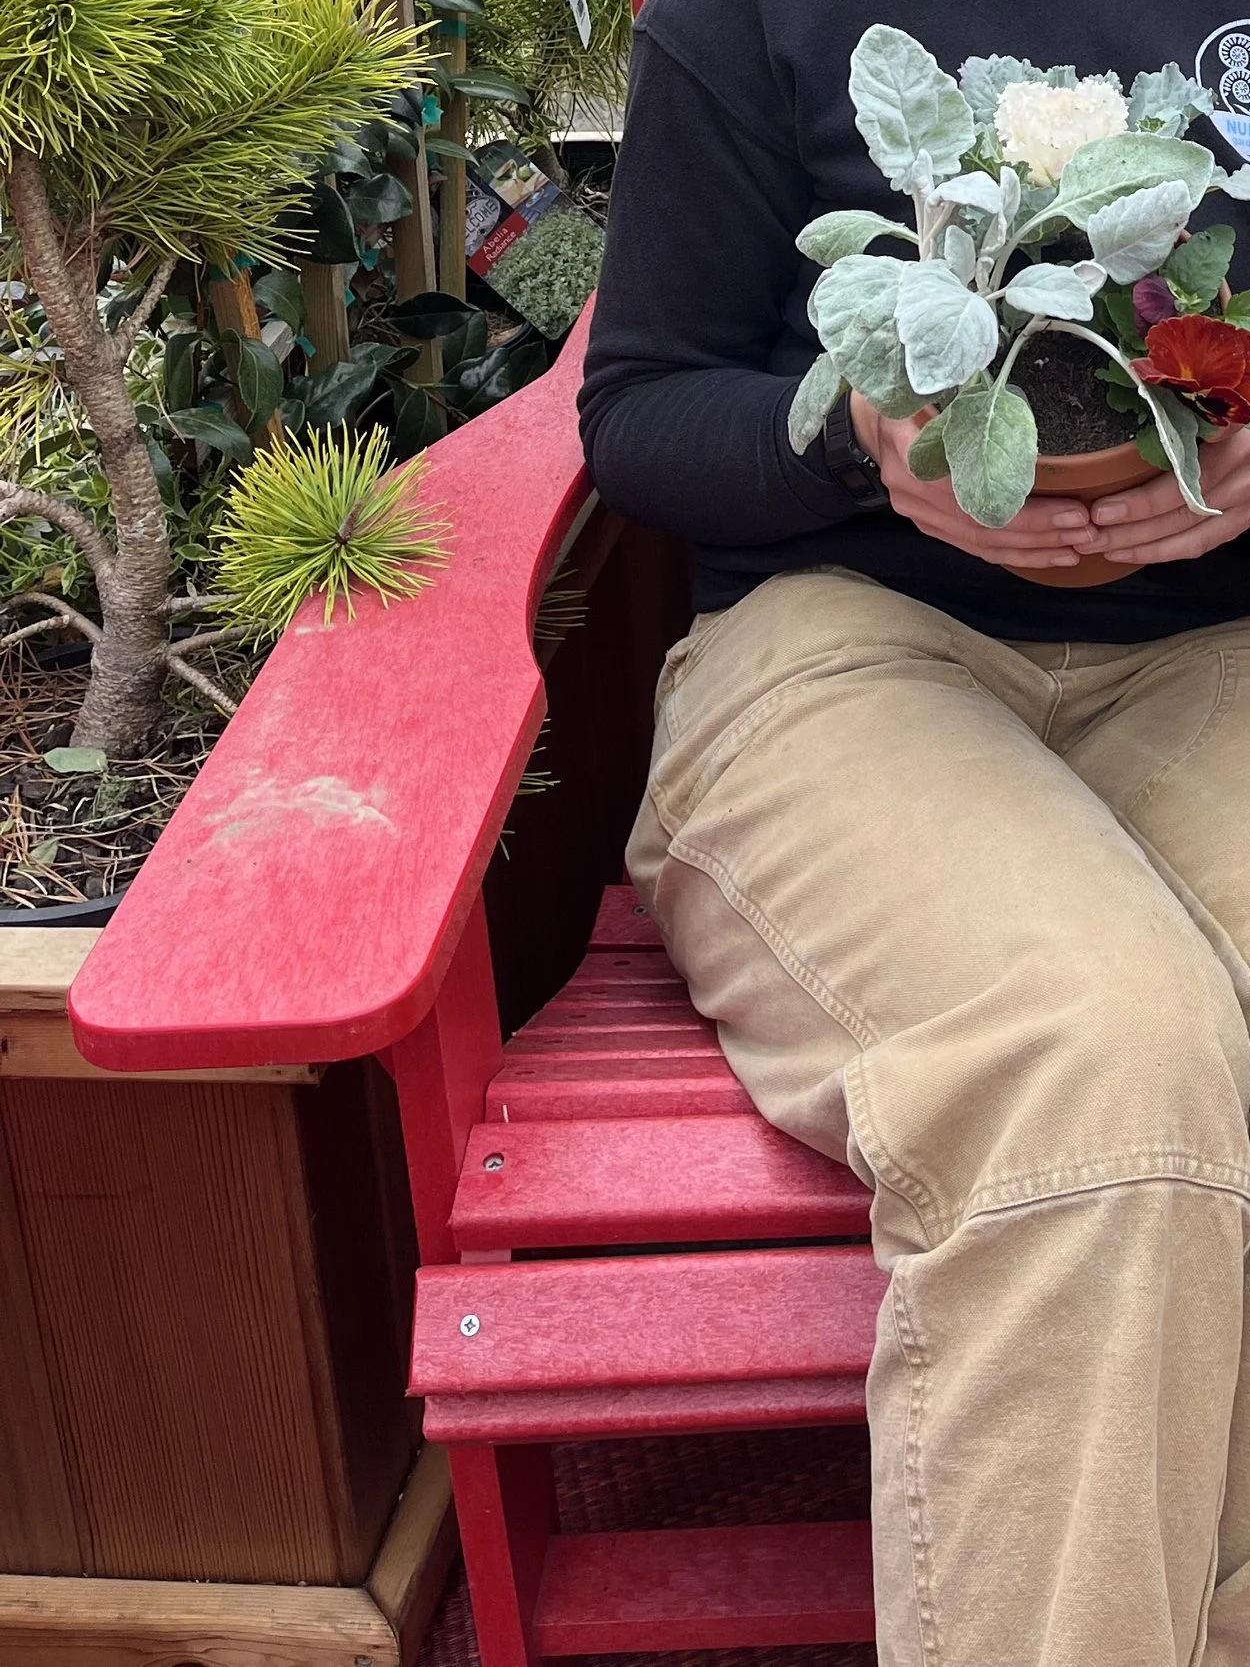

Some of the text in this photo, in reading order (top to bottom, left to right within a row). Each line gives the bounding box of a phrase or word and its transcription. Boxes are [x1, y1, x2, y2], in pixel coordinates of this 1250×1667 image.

[465, 198, 499, 239] LCOME
[482, 227, 509, 254] Abelia
[485, 231, 517, 262] Radiance
